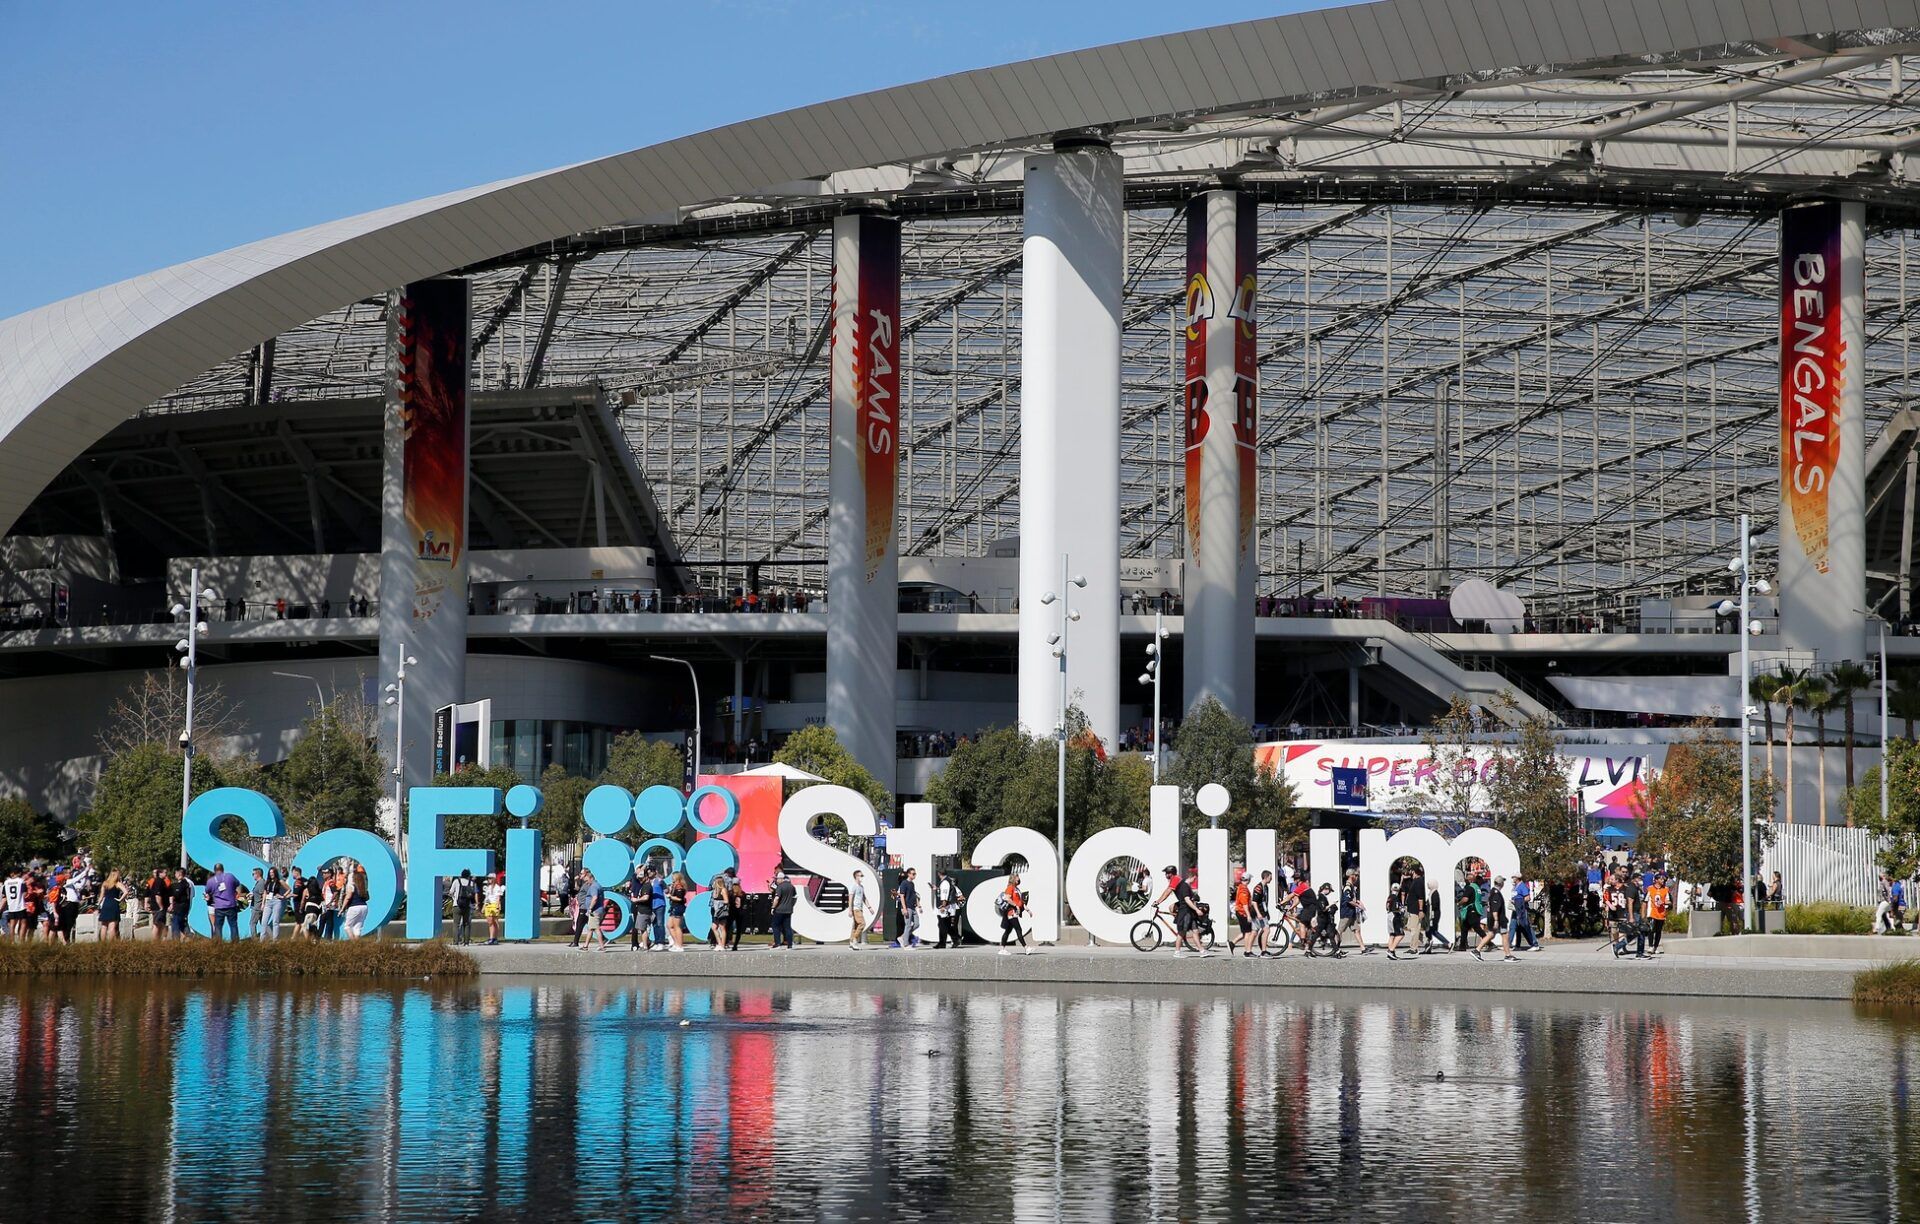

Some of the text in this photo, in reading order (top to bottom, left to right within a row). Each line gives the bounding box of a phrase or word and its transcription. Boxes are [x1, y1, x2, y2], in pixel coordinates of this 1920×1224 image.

[868, 308, 892, 454] RAMS
[1793, 253, 1826, 495] BENGALS
[436, 716, 444, 749] Stadium
[1578, 756, 1643, 787] LVI
[182, 783, 1522, 945] SoFi Stadium
[10, 885, 18, 899] 9
[1611, 892, 1626, 908] 58
